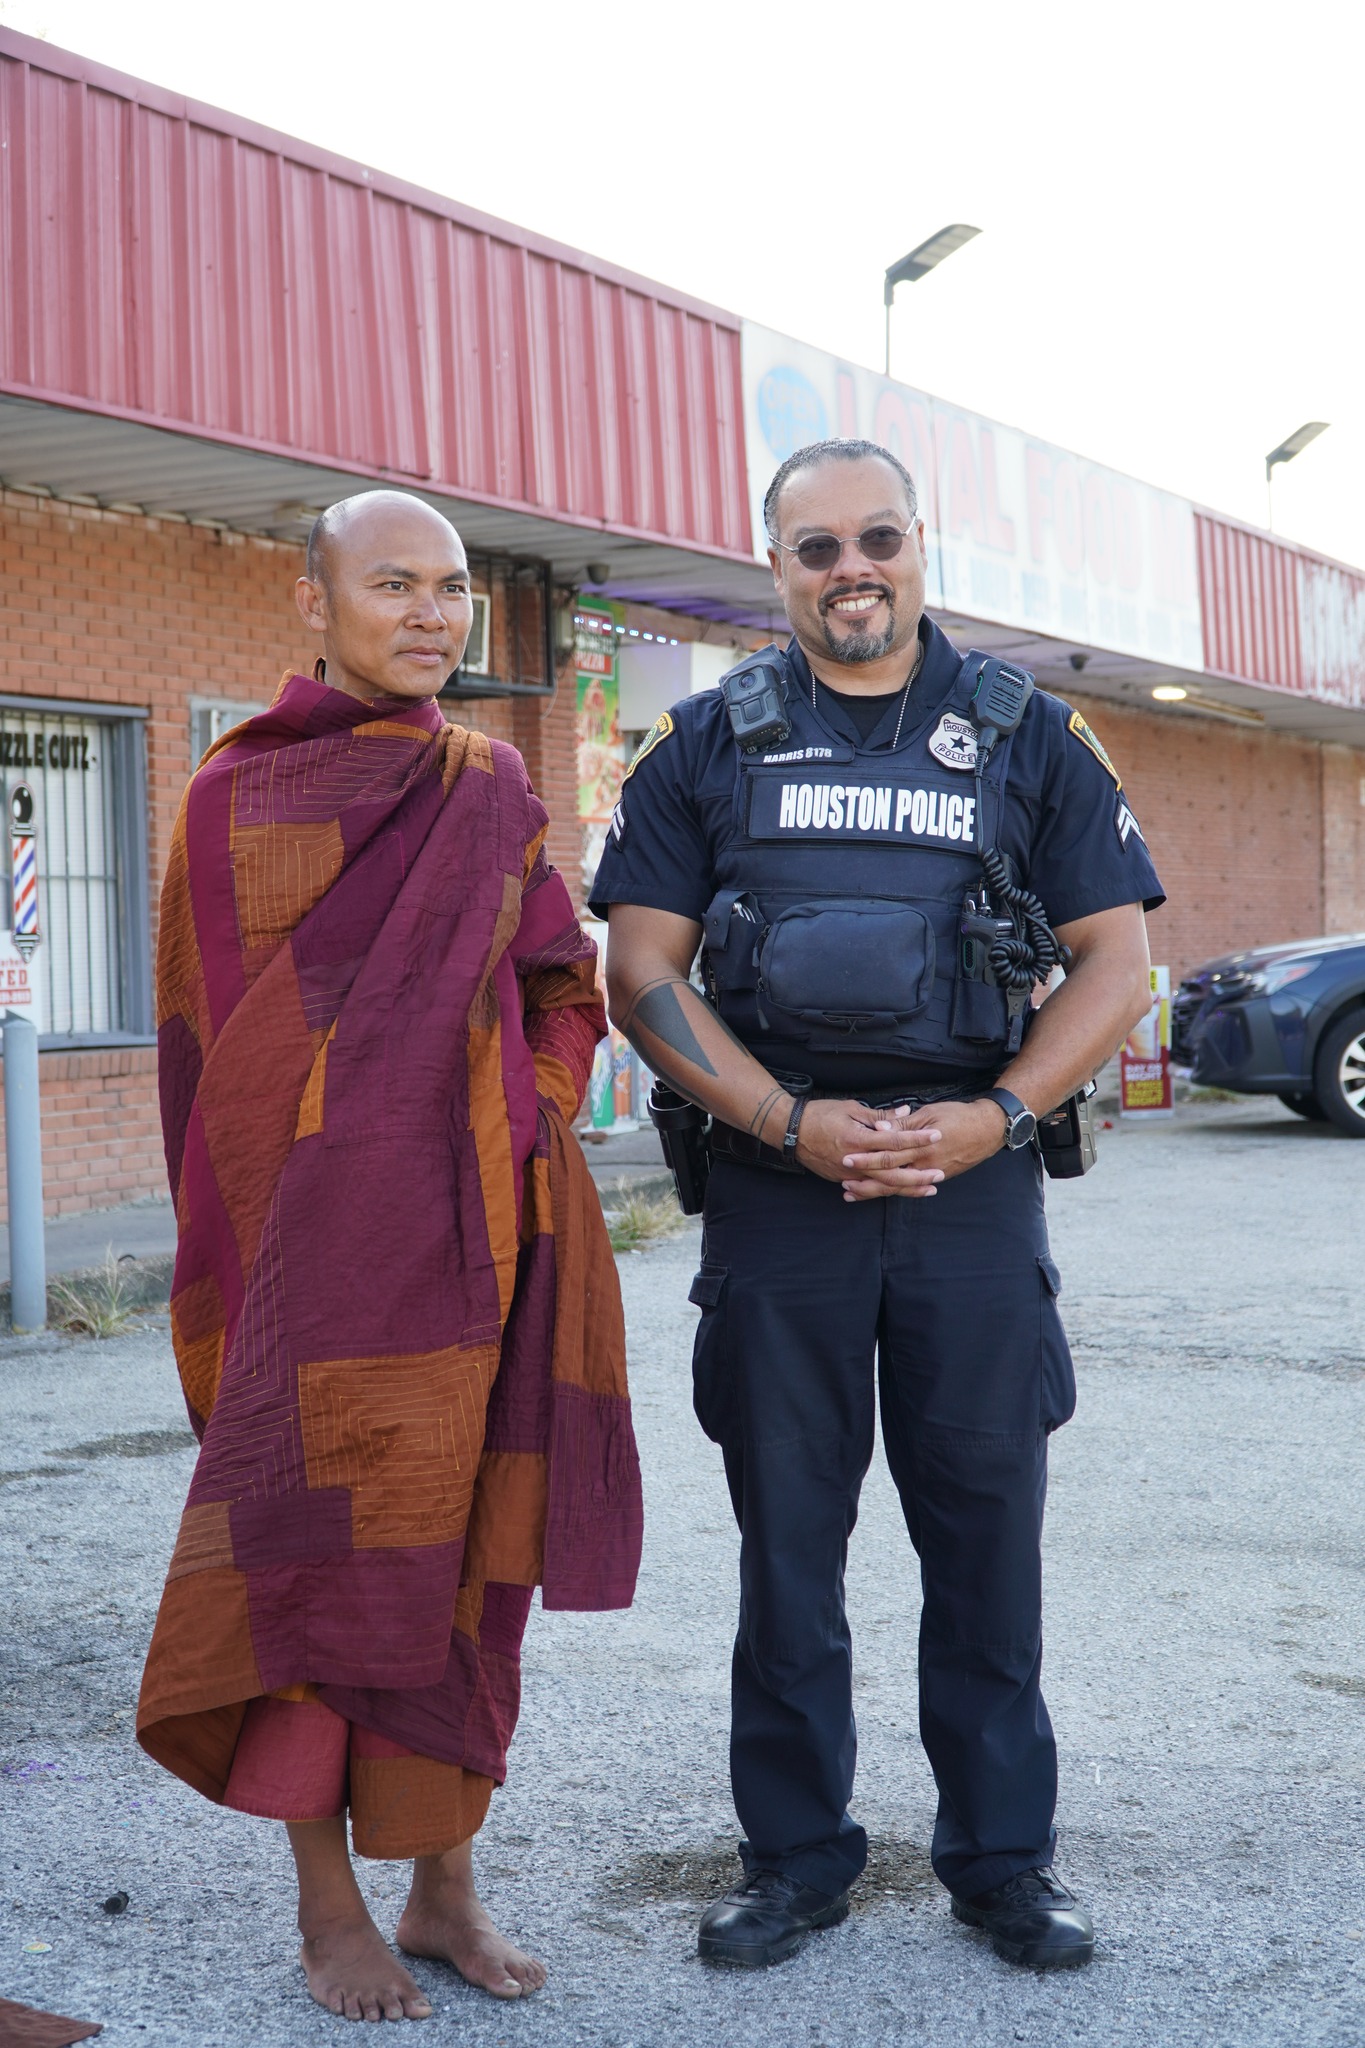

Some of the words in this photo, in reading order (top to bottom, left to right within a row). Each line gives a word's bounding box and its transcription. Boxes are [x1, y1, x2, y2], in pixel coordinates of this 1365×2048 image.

[1025, 446, 1143, 592] FOOD
[763, 749, 804, 763] HARRIS
[938, 747, 974, 763] POLICE
[779, 784, 892, 831] HOUSTON
[894, 788, 976, 842] POLICE
